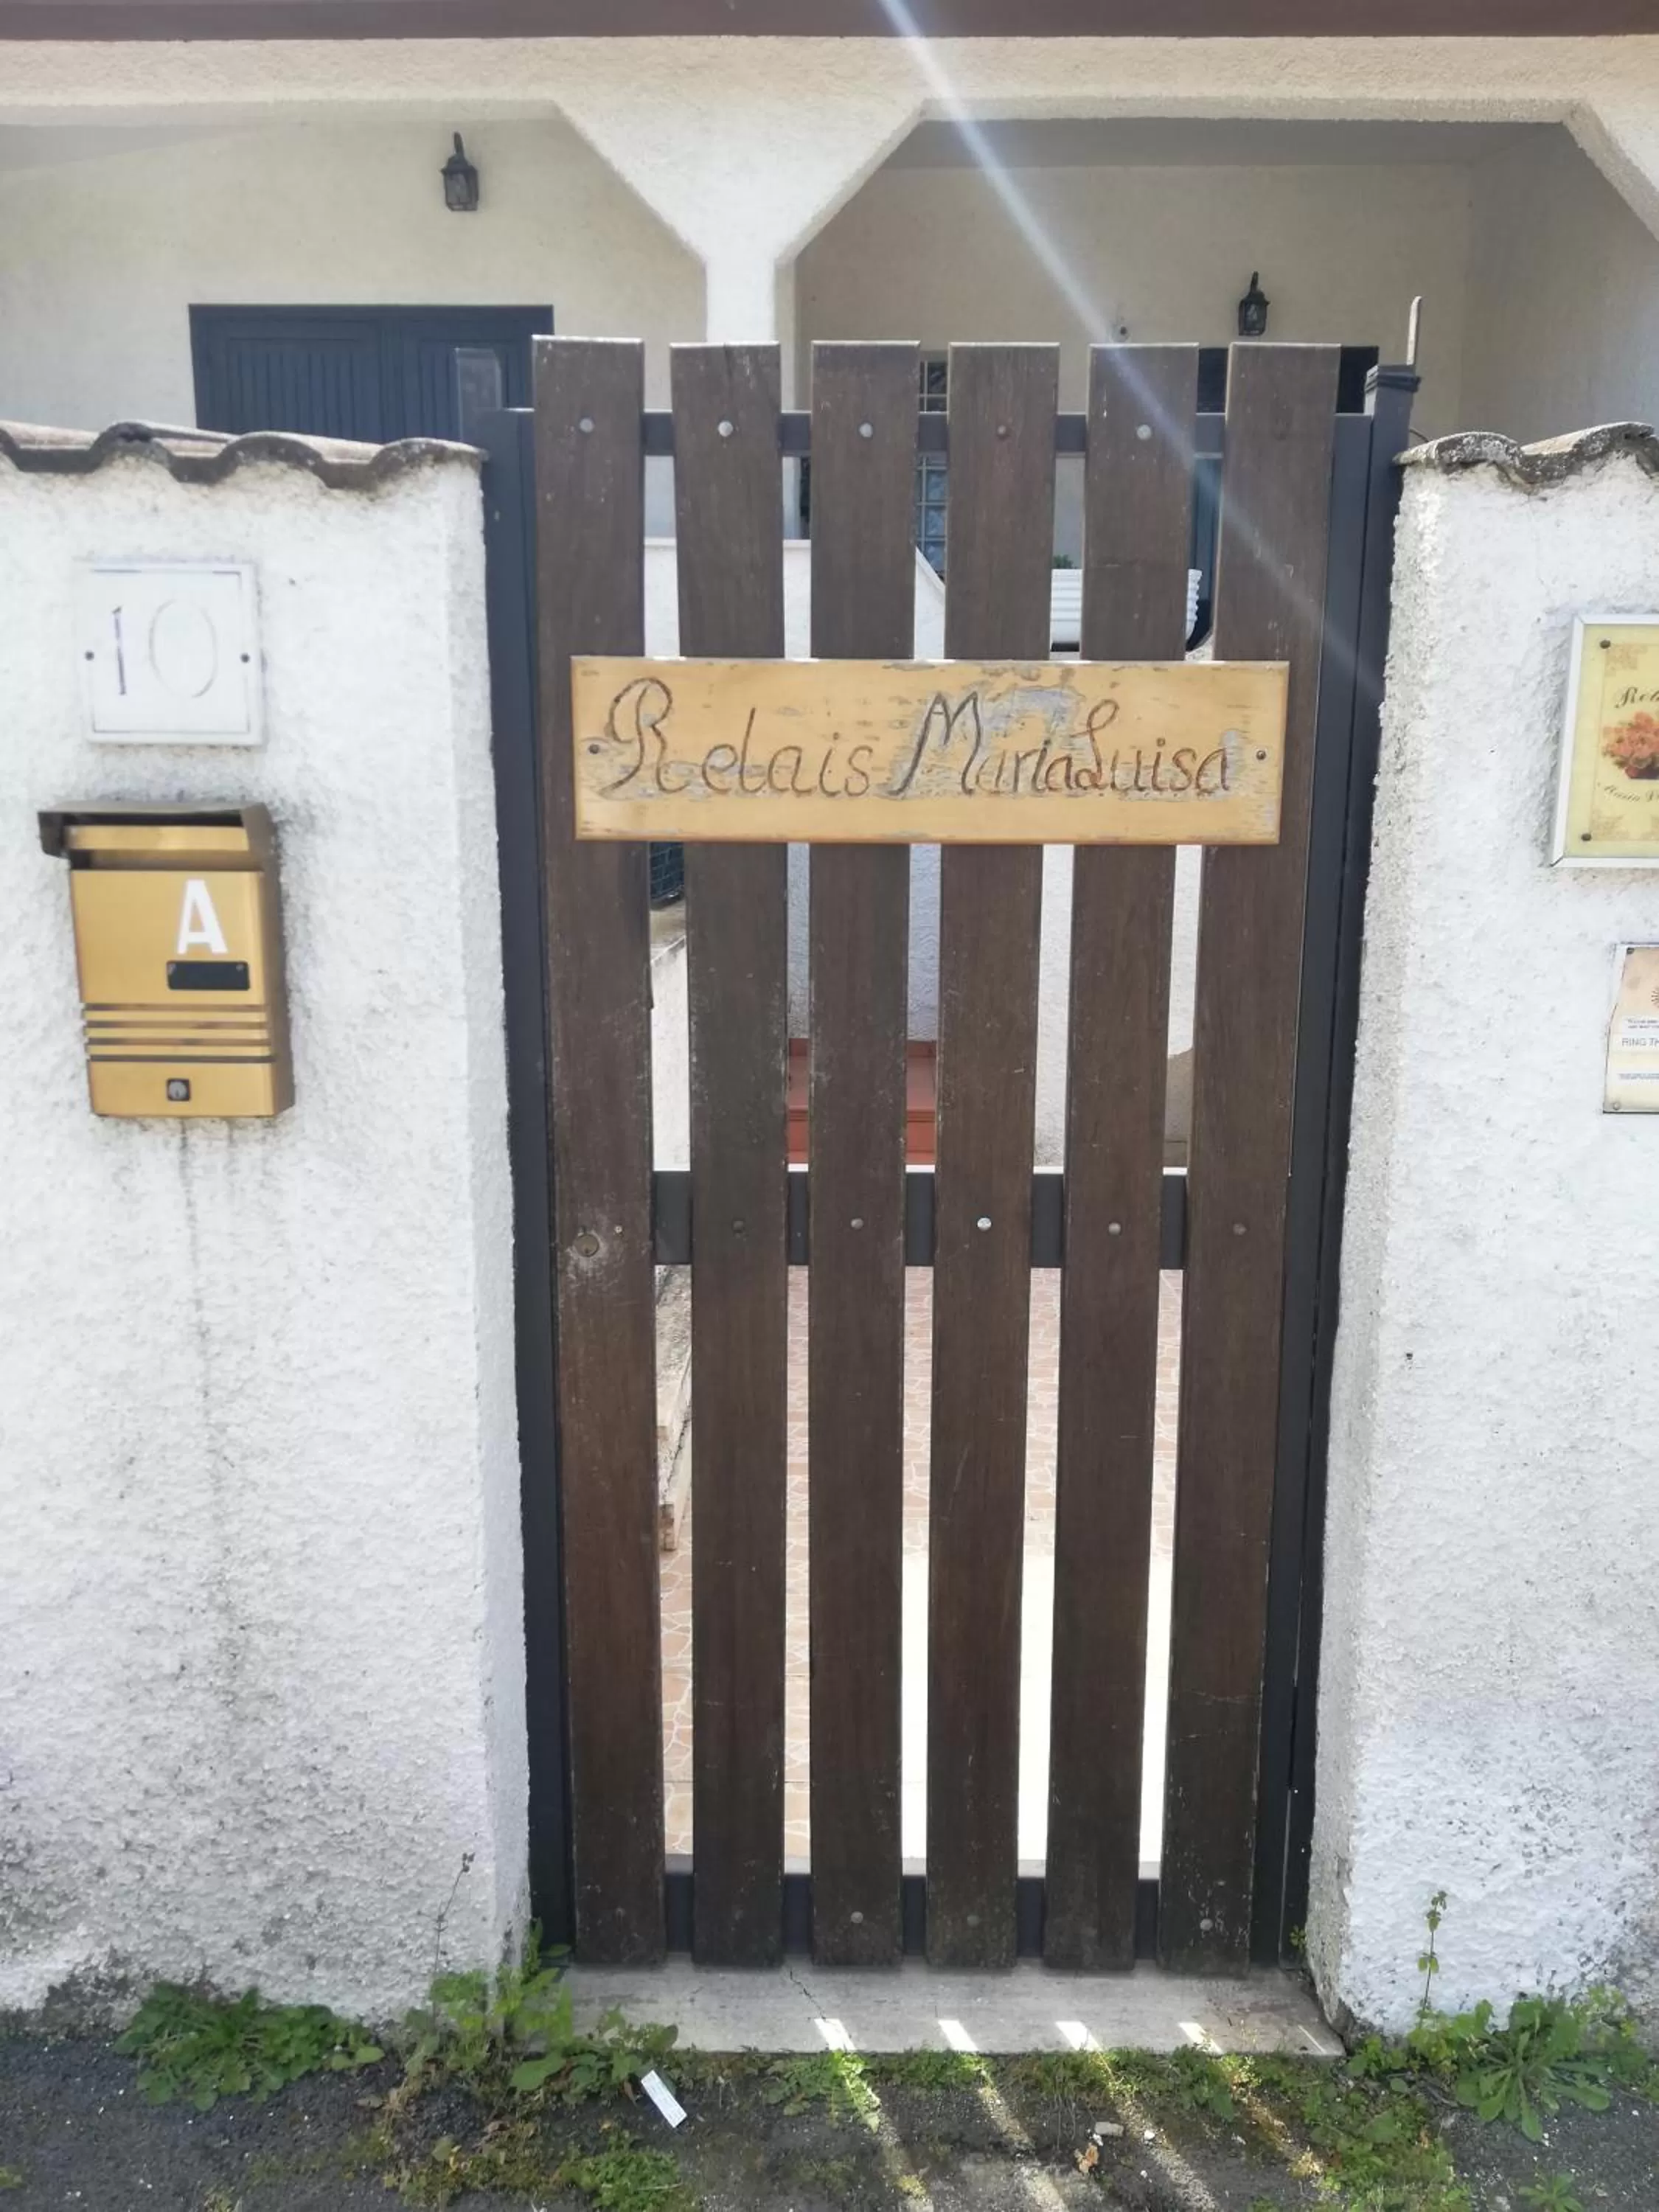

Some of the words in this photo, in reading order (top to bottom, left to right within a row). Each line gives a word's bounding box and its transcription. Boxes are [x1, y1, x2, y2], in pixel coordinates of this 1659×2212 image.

[111, 597, 219, 698] 10
[599, 676, 873, 797] Relais
[175, 880, 227, 954] A
[1622, 1037, 1646, 1047] RING
